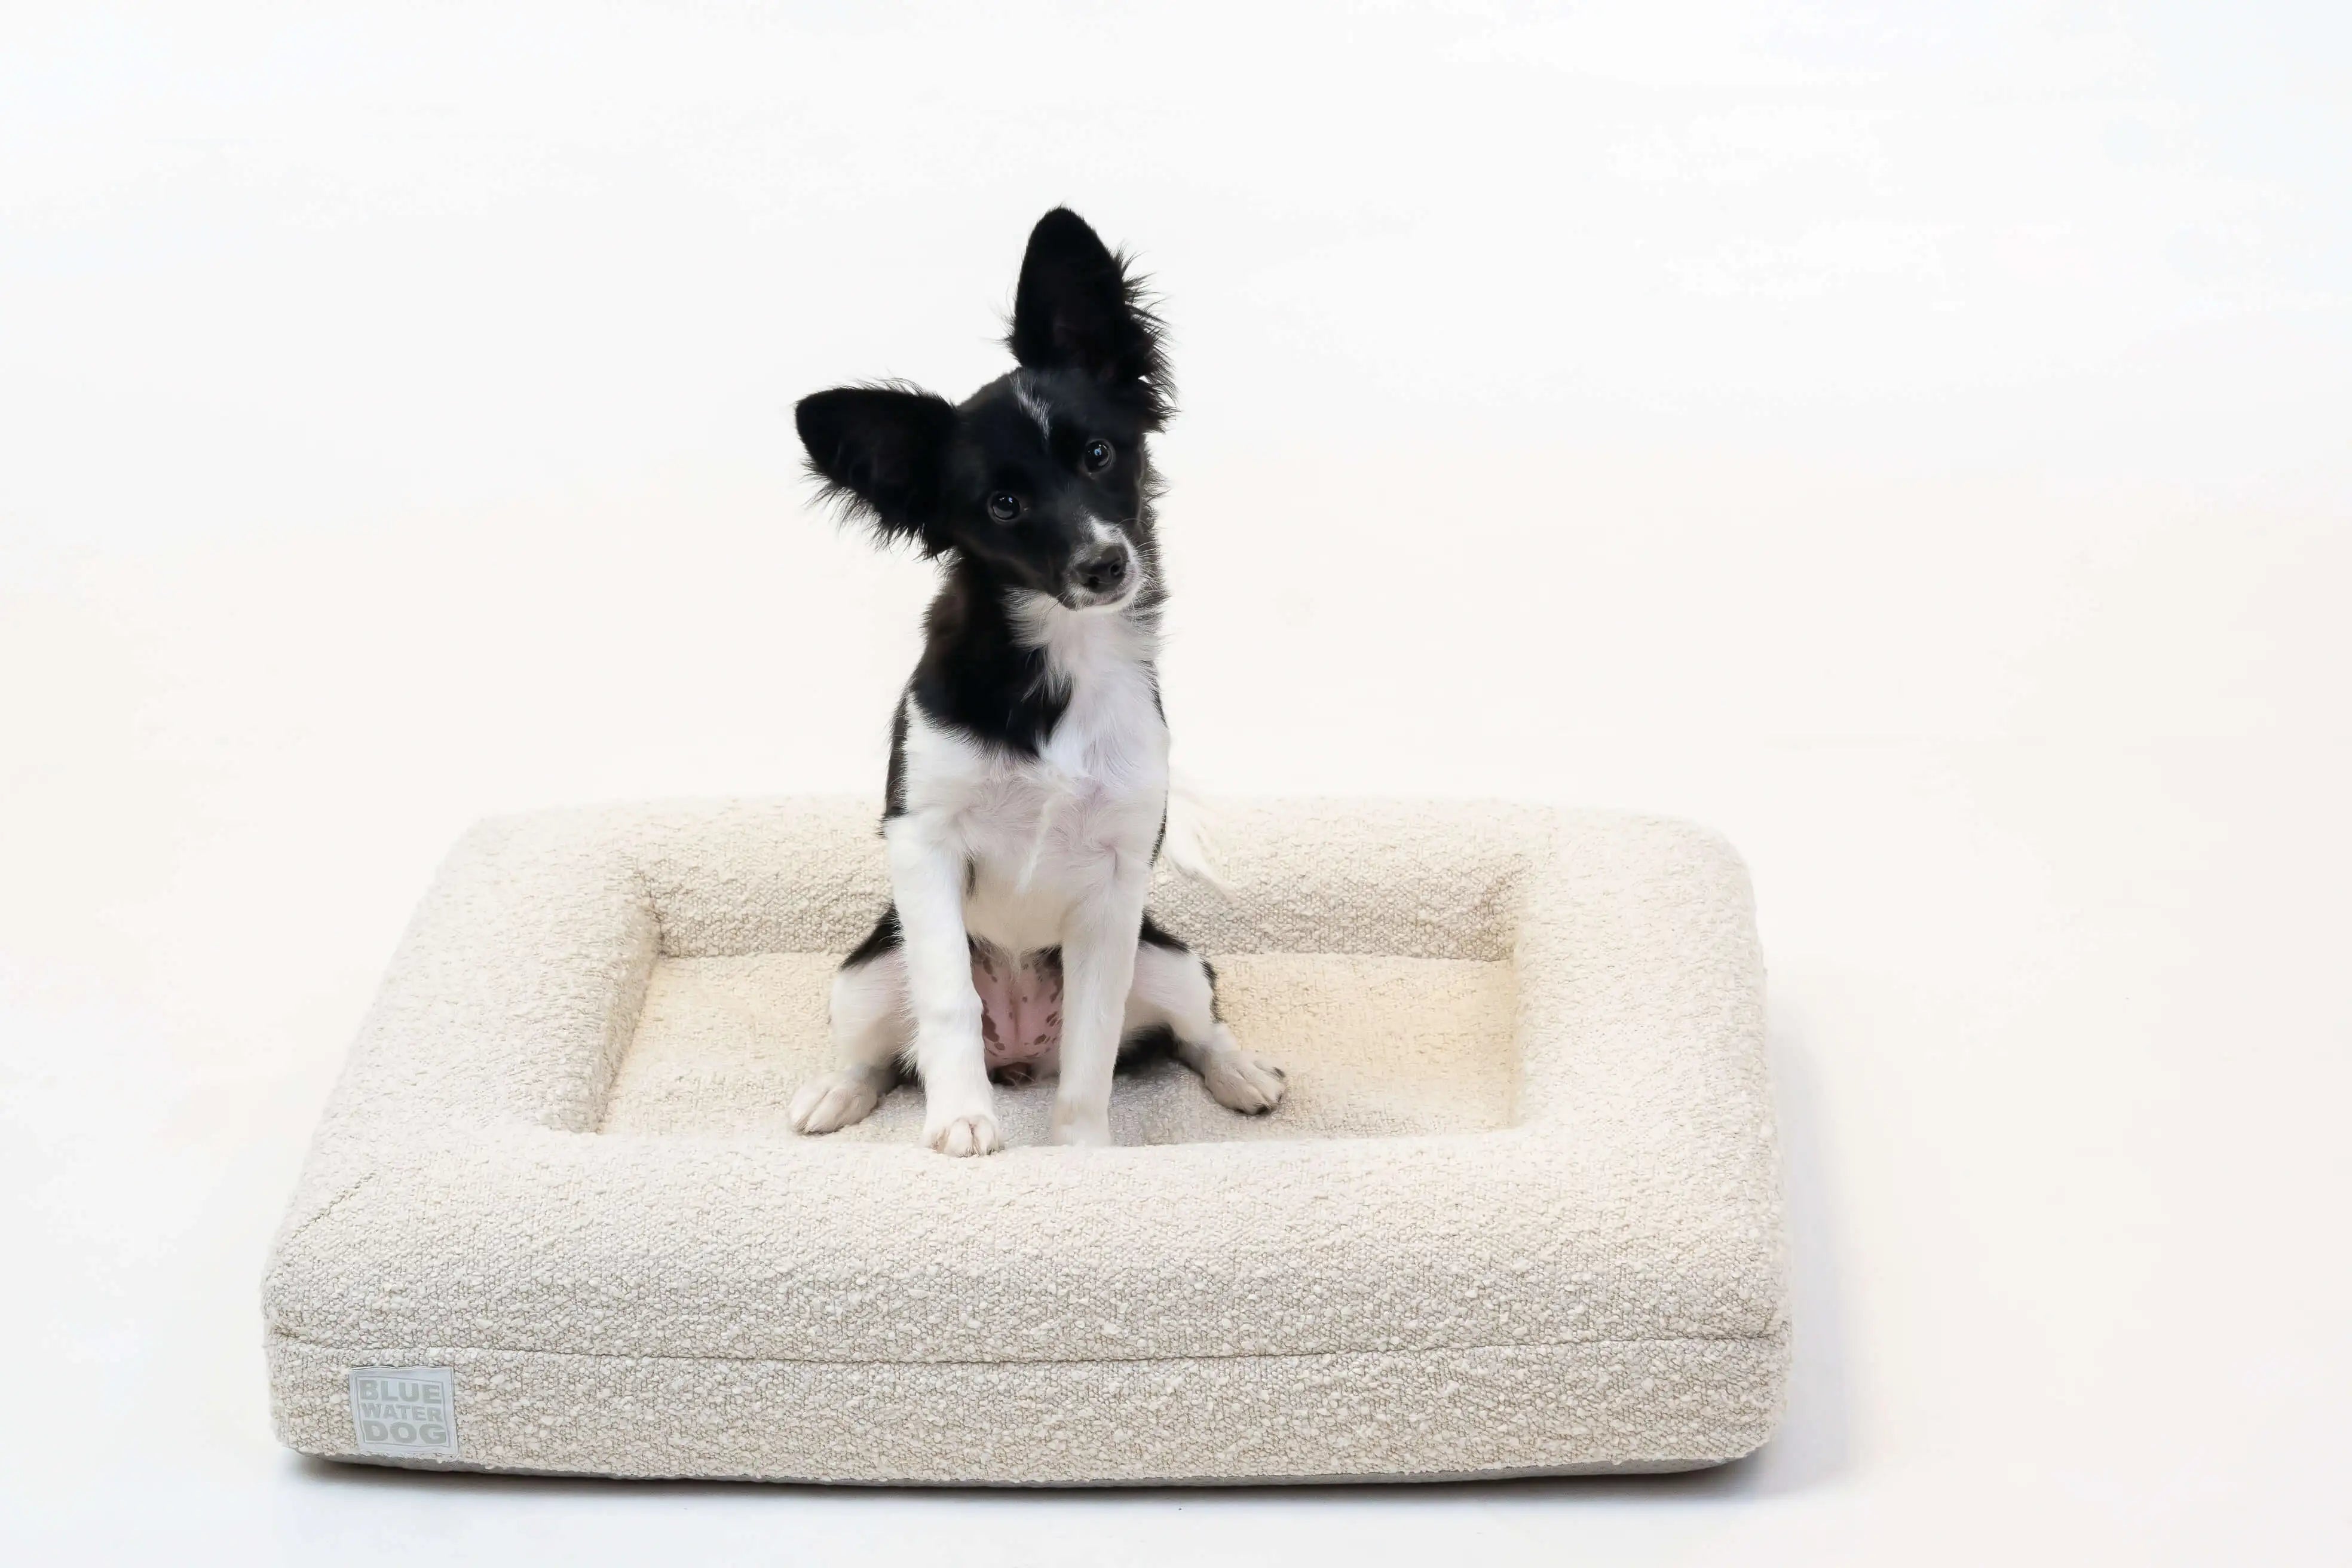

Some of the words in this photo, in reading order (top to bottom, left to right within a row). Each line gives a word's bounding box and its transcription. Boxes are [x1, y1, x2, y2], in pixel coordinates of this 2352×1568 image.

[359, 1380, 442, 1403] BLUE
[362, 1403, 443, 1420] WATER
[363, 1421, 446, 1444] DOG
